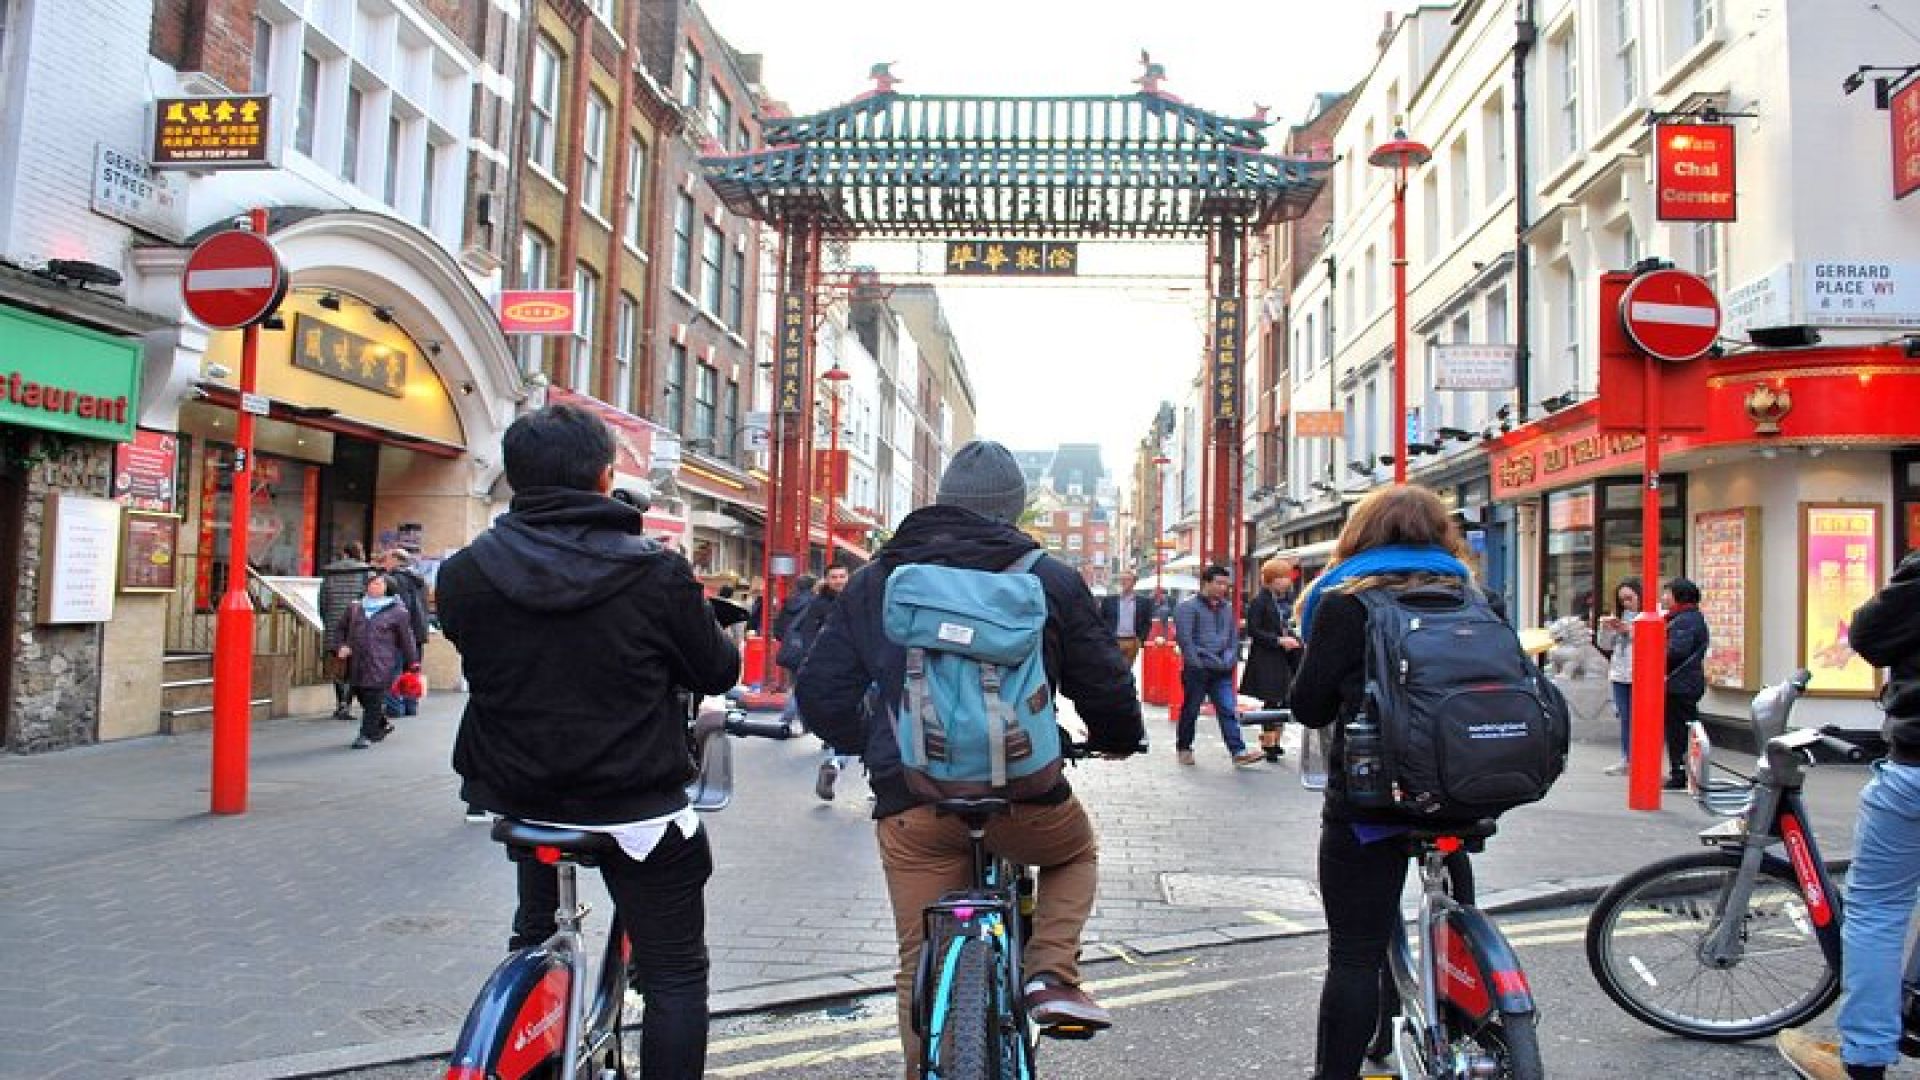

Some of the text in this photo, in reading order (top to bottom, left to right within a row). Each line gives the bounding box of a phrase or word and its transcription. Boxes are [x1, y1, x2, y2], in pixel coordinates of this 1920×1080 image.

[103, 149, 168, 190] GERRAD
[1673, 161, 1719, 176] Chai
[103, 167, 153, 199] STREET
[1662, 188, 1732, 204] Corner
[1814, 264, 1891, 279] GERRARD
[1815, 280, 1895, 296] PLACE W1
